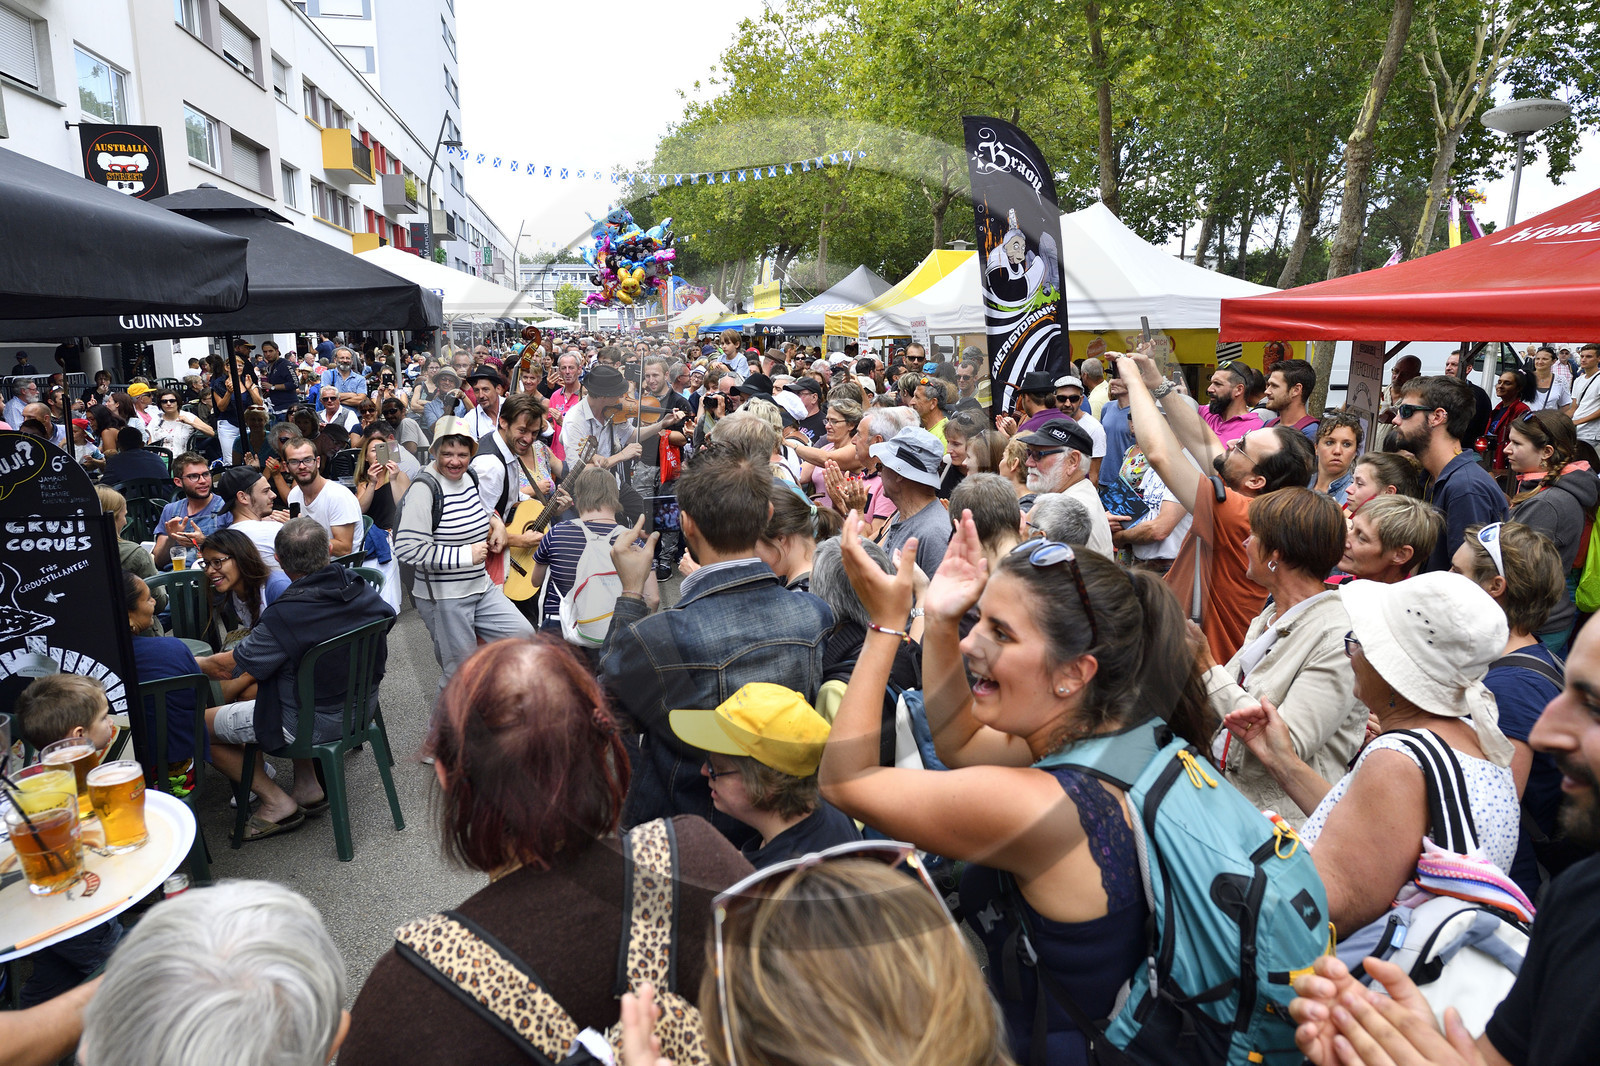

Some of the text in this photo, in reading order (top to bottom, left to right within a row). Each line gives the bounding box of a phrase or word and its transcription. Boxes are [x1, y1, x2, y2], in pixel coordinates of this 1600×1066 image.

[94, 143, 149, 153] AUSTRALIA
[105, 172, 144, 181] STREET
[118, 313, 203, 330] GUINNESS
[991, 304, 1056, 380] ENERGYDRINK
[6, 536, 92, 552] COQUES
